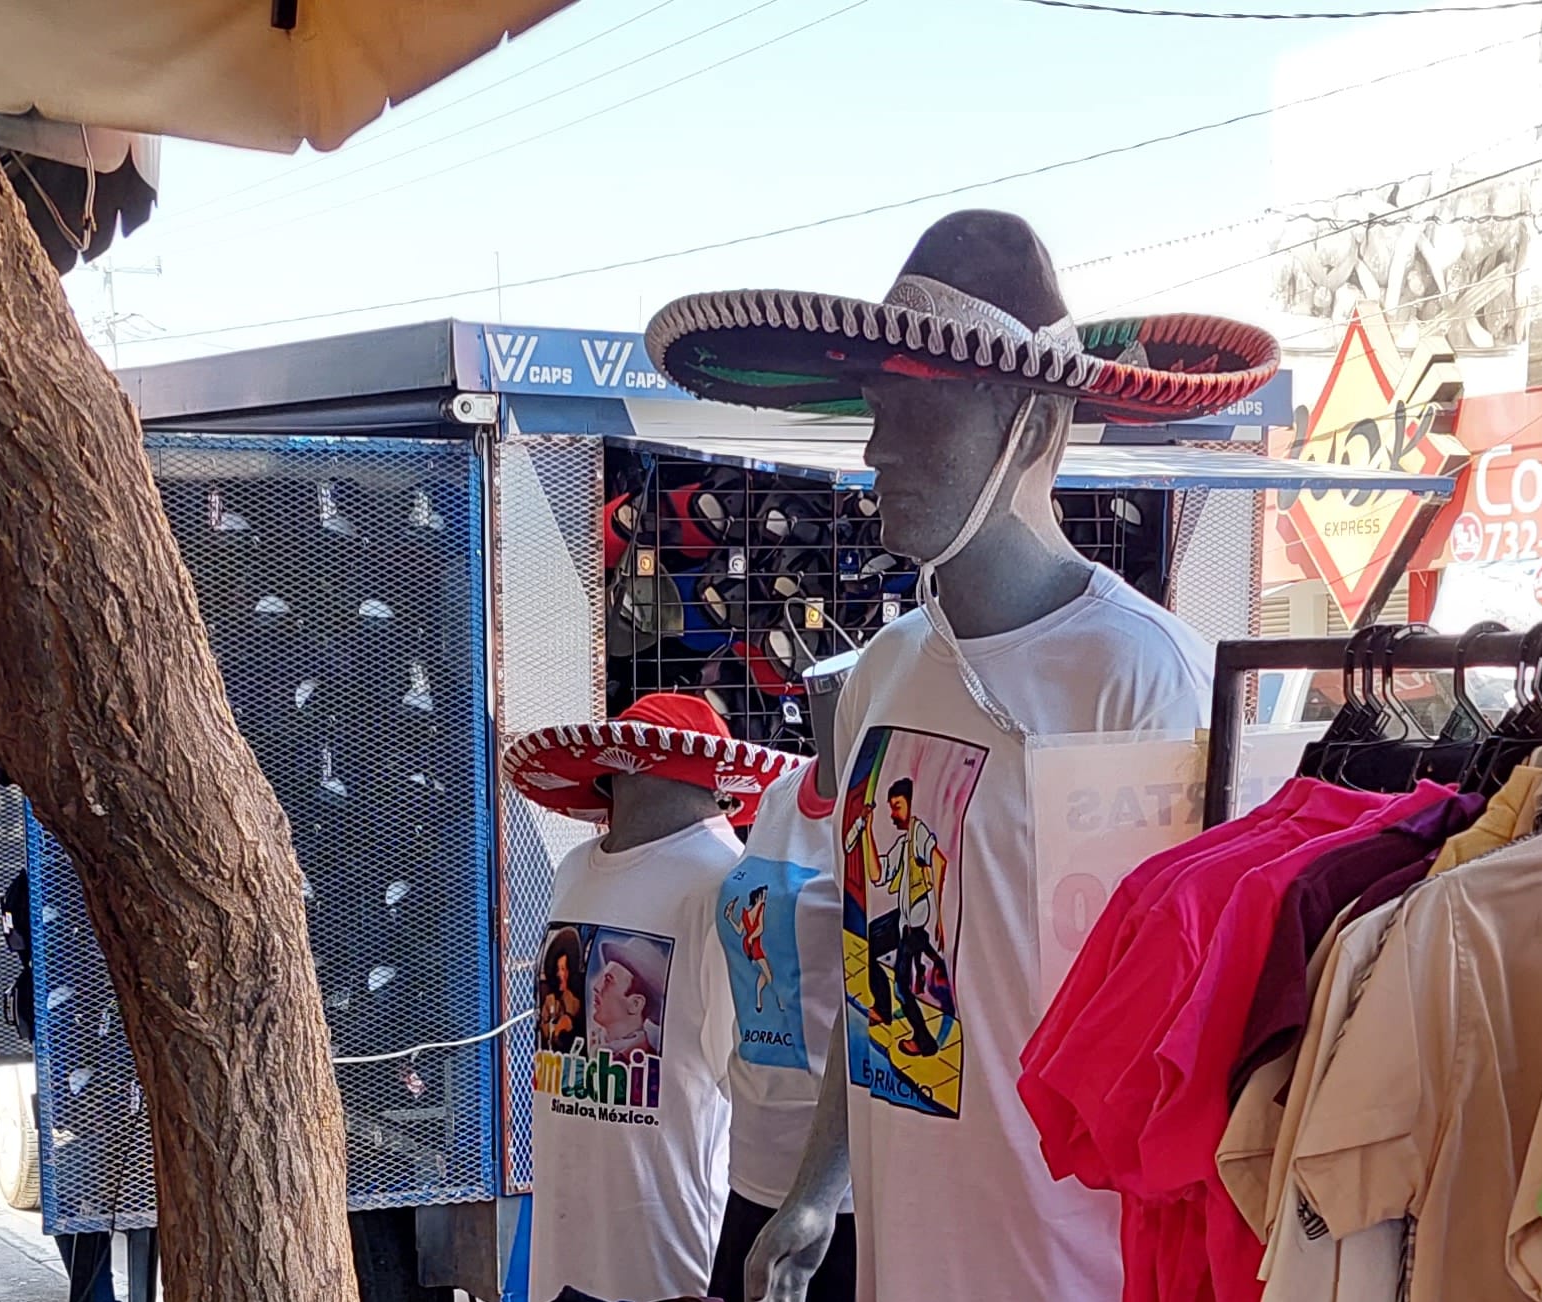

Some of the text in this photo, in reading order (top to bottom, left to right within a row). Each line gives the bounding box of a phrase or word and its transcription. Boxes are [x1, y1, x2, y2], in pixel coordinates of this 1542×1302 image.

[529, 365, 574, 385] CAPS
[624, 370, 668, 390] CAPS
[1323, 517, 1381, 538] EXPRESS
[744, 1028, 794, 1047] BORRAC
[532, 1036, 661, 1109] múchil
